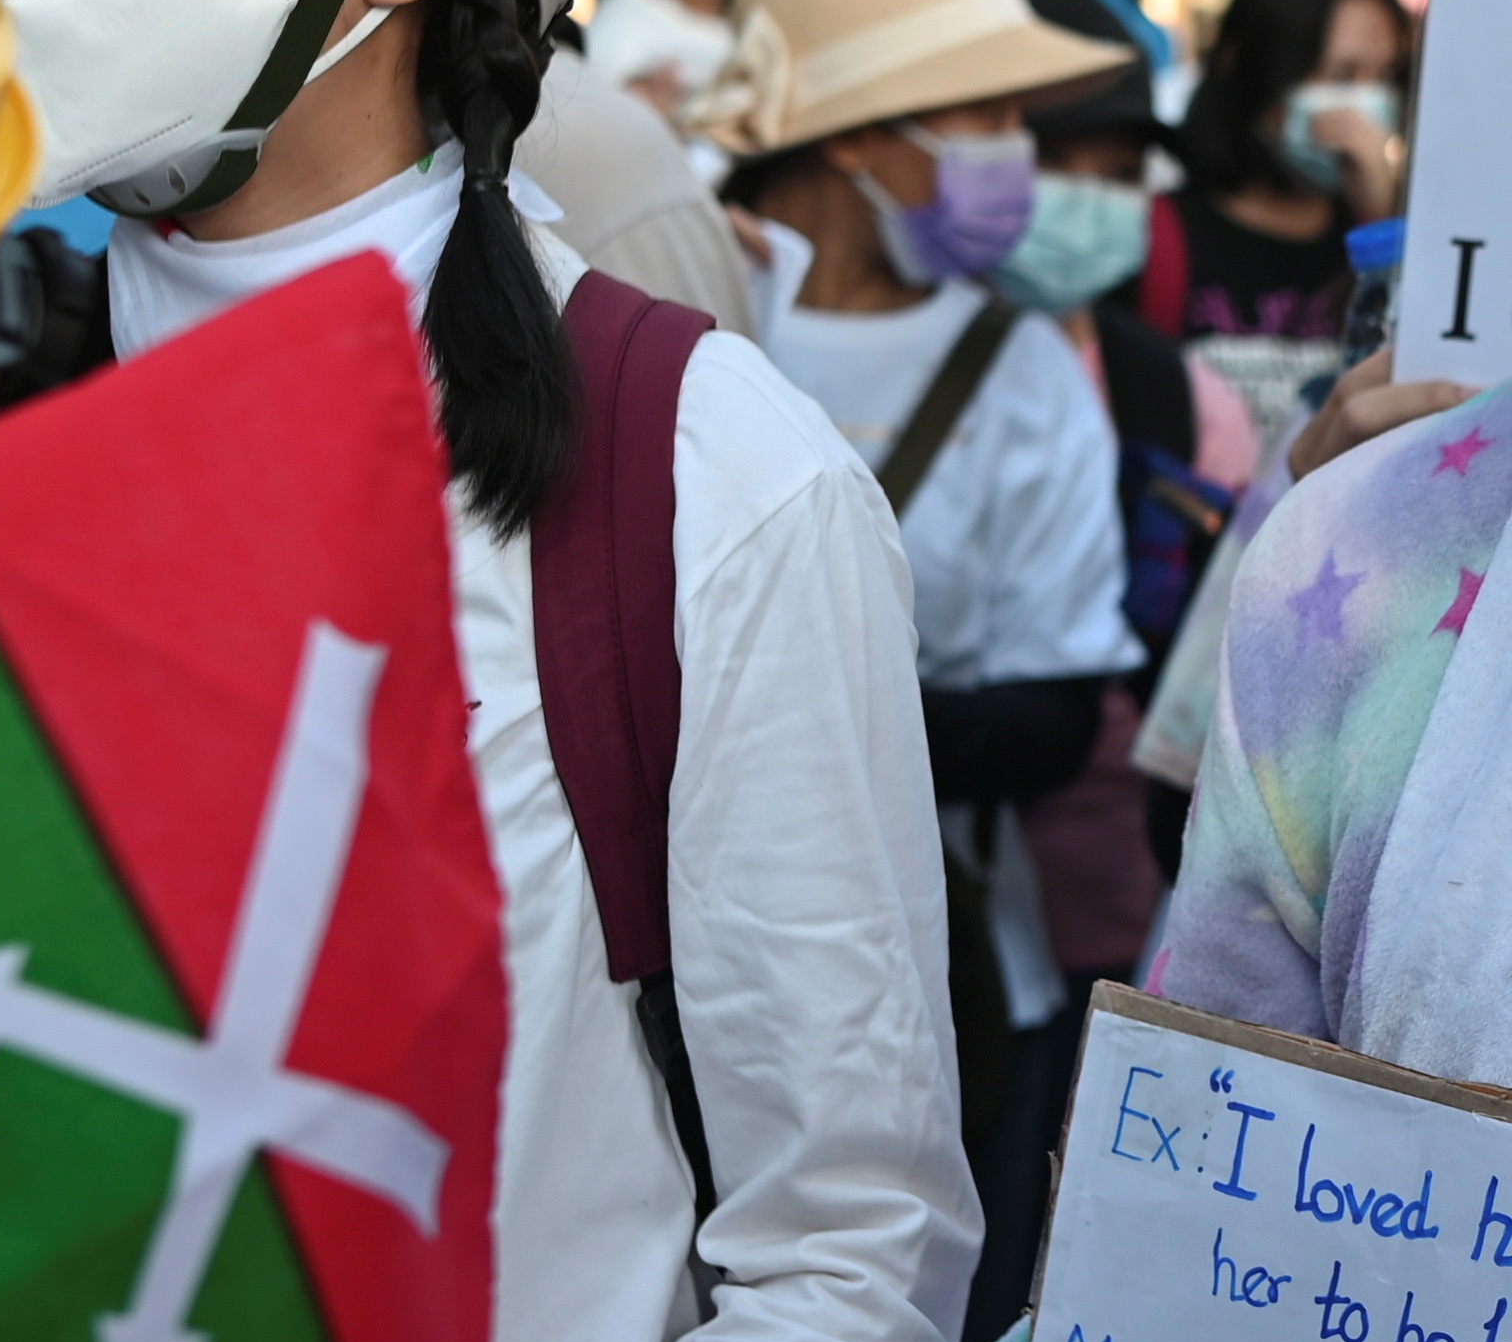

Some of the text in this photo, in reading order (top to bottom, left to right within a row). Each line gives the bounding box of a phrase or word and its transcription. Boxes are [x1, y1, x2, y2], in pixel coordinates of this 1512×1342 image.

[1440, 236, 1487, 343] I
[1294, 1123, 1440, 1240] loved
[1212, 1227, 1292, 1308] her
